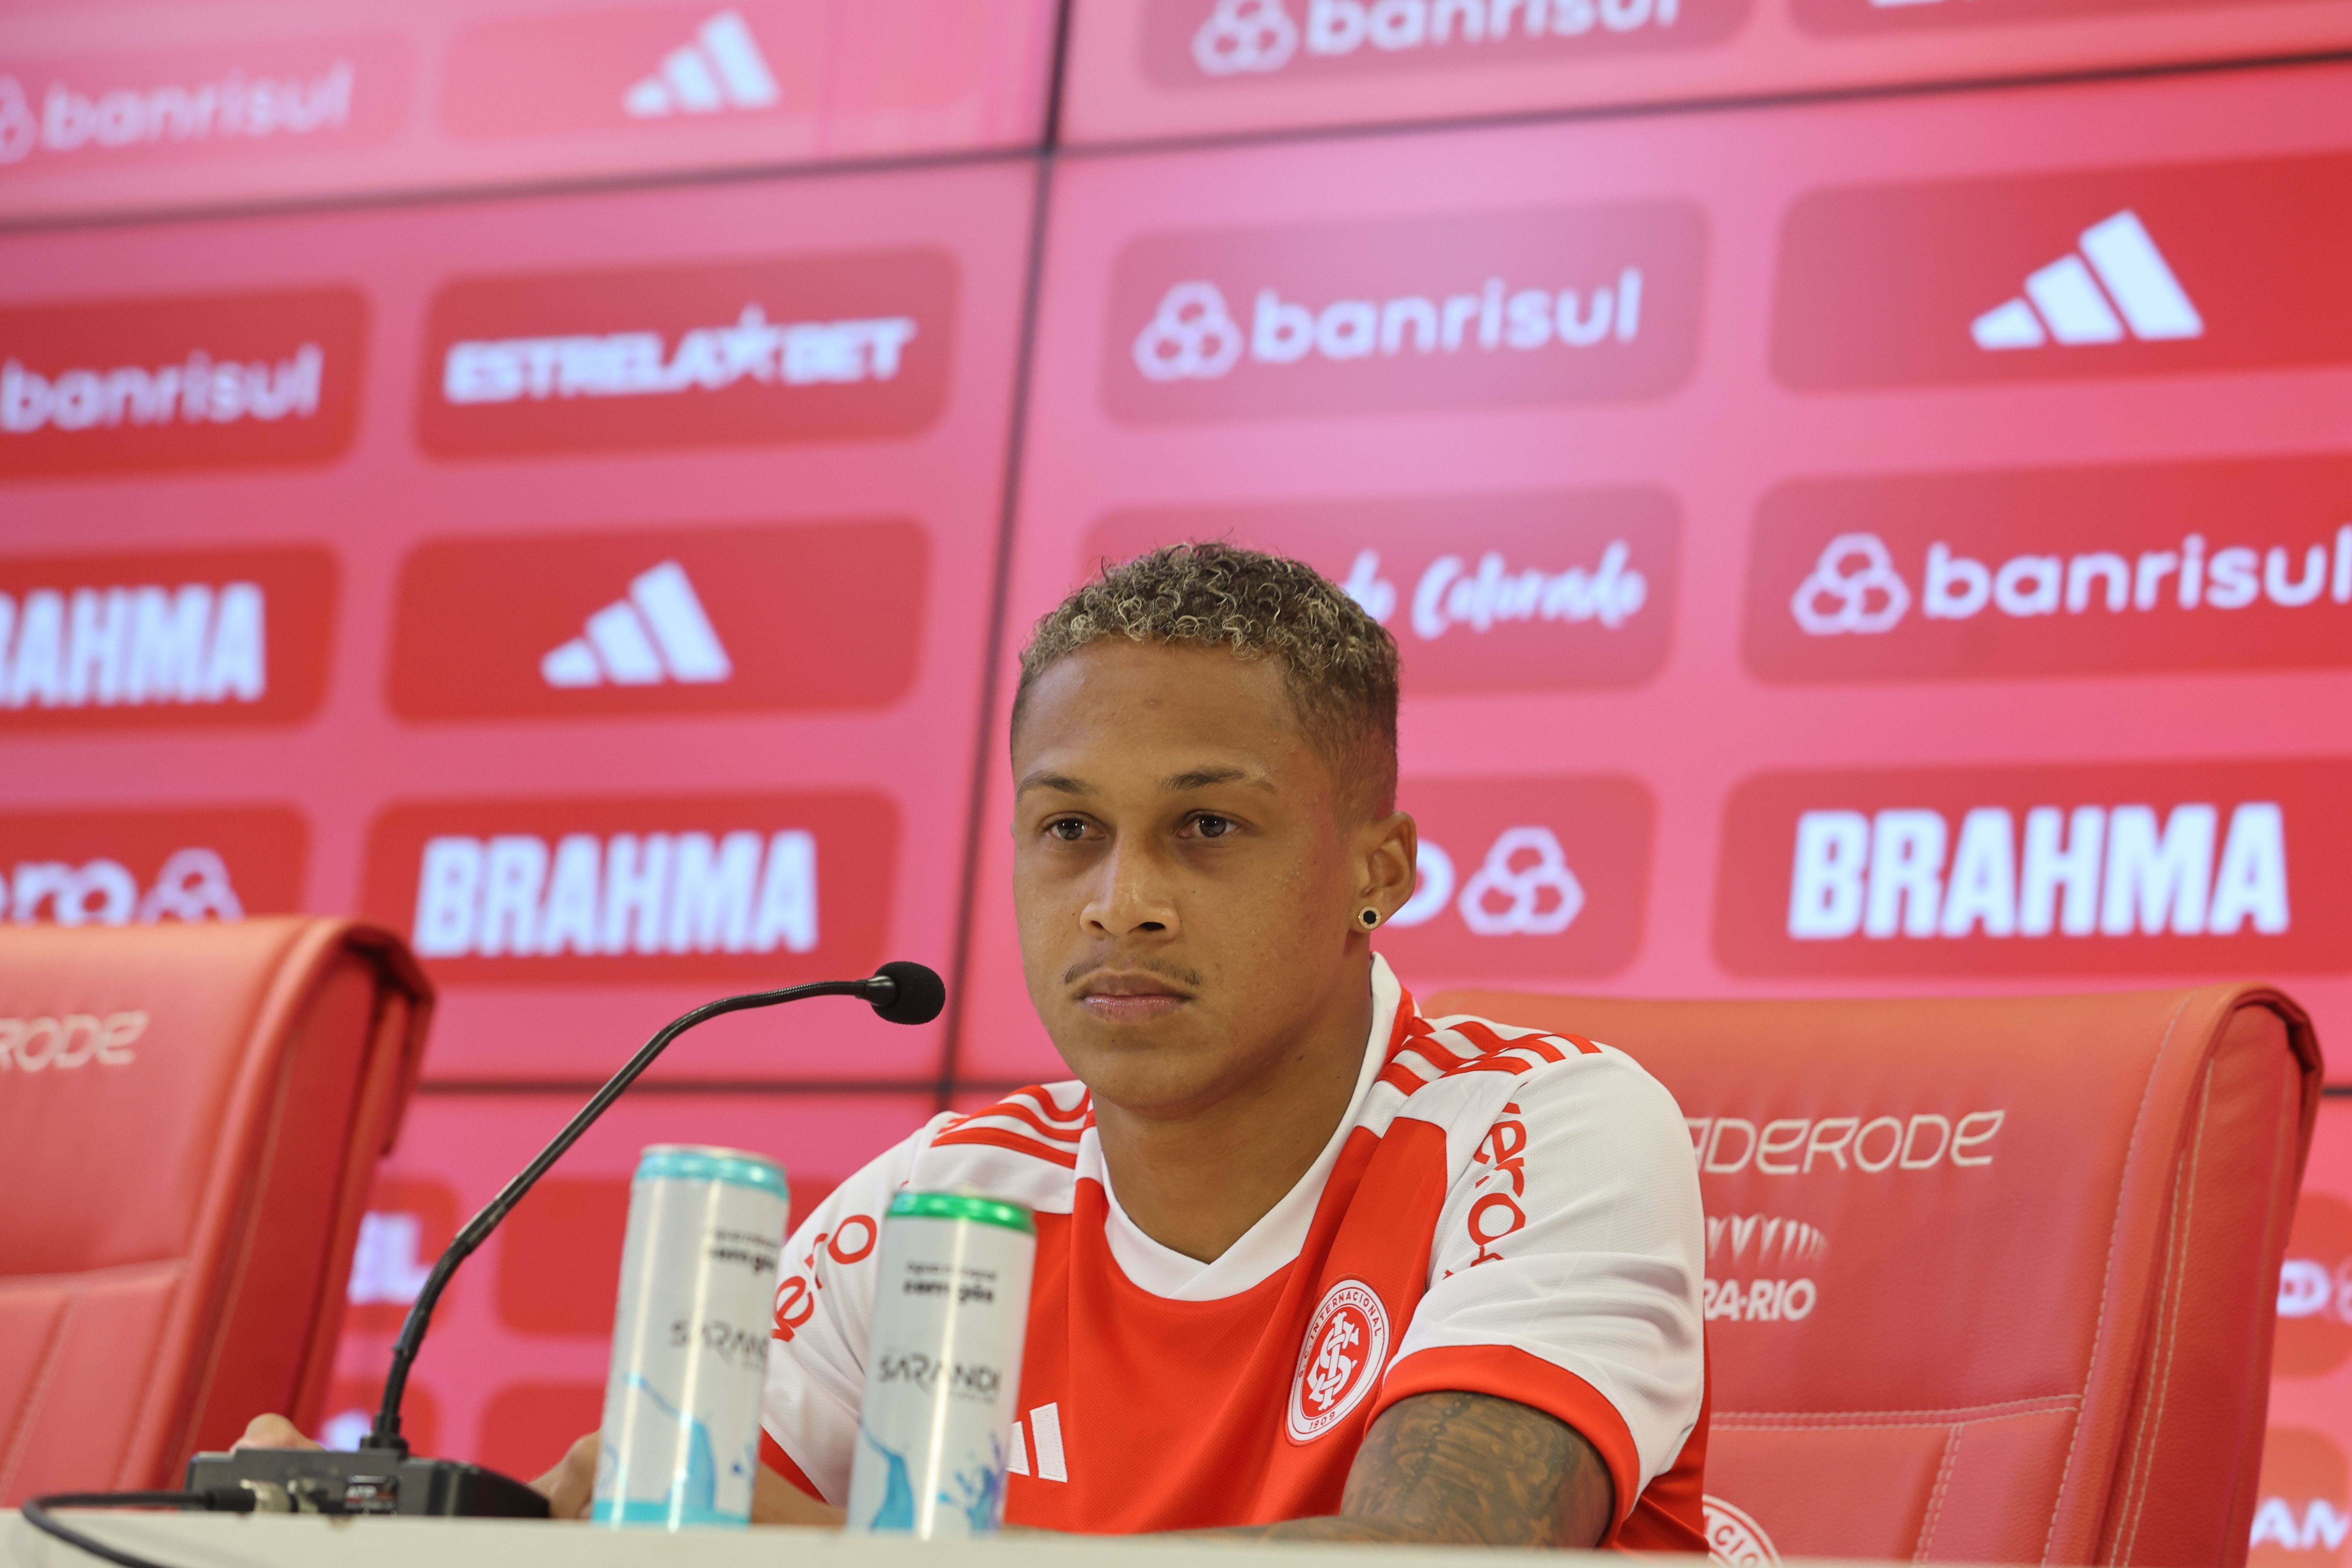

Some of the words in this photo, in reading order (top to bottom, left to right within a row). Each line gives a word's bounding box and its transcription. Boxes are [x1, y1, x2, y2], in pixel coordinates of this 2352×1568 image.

[41, 58, 355, 152] banrisul
[1252, 266, 1643, 365] banrisul
[0, 347, 324, 434] banrisul
[1922, 524, 2352, 619] banrisul
[412, 829, 819, 959] BRAHMA
[1788, 802, 2290, 940] BRAHMA
[1310, 1291, 1382, 1341] INTERNACIONAL
[1309, 1411, 1335, 1431] 1909
